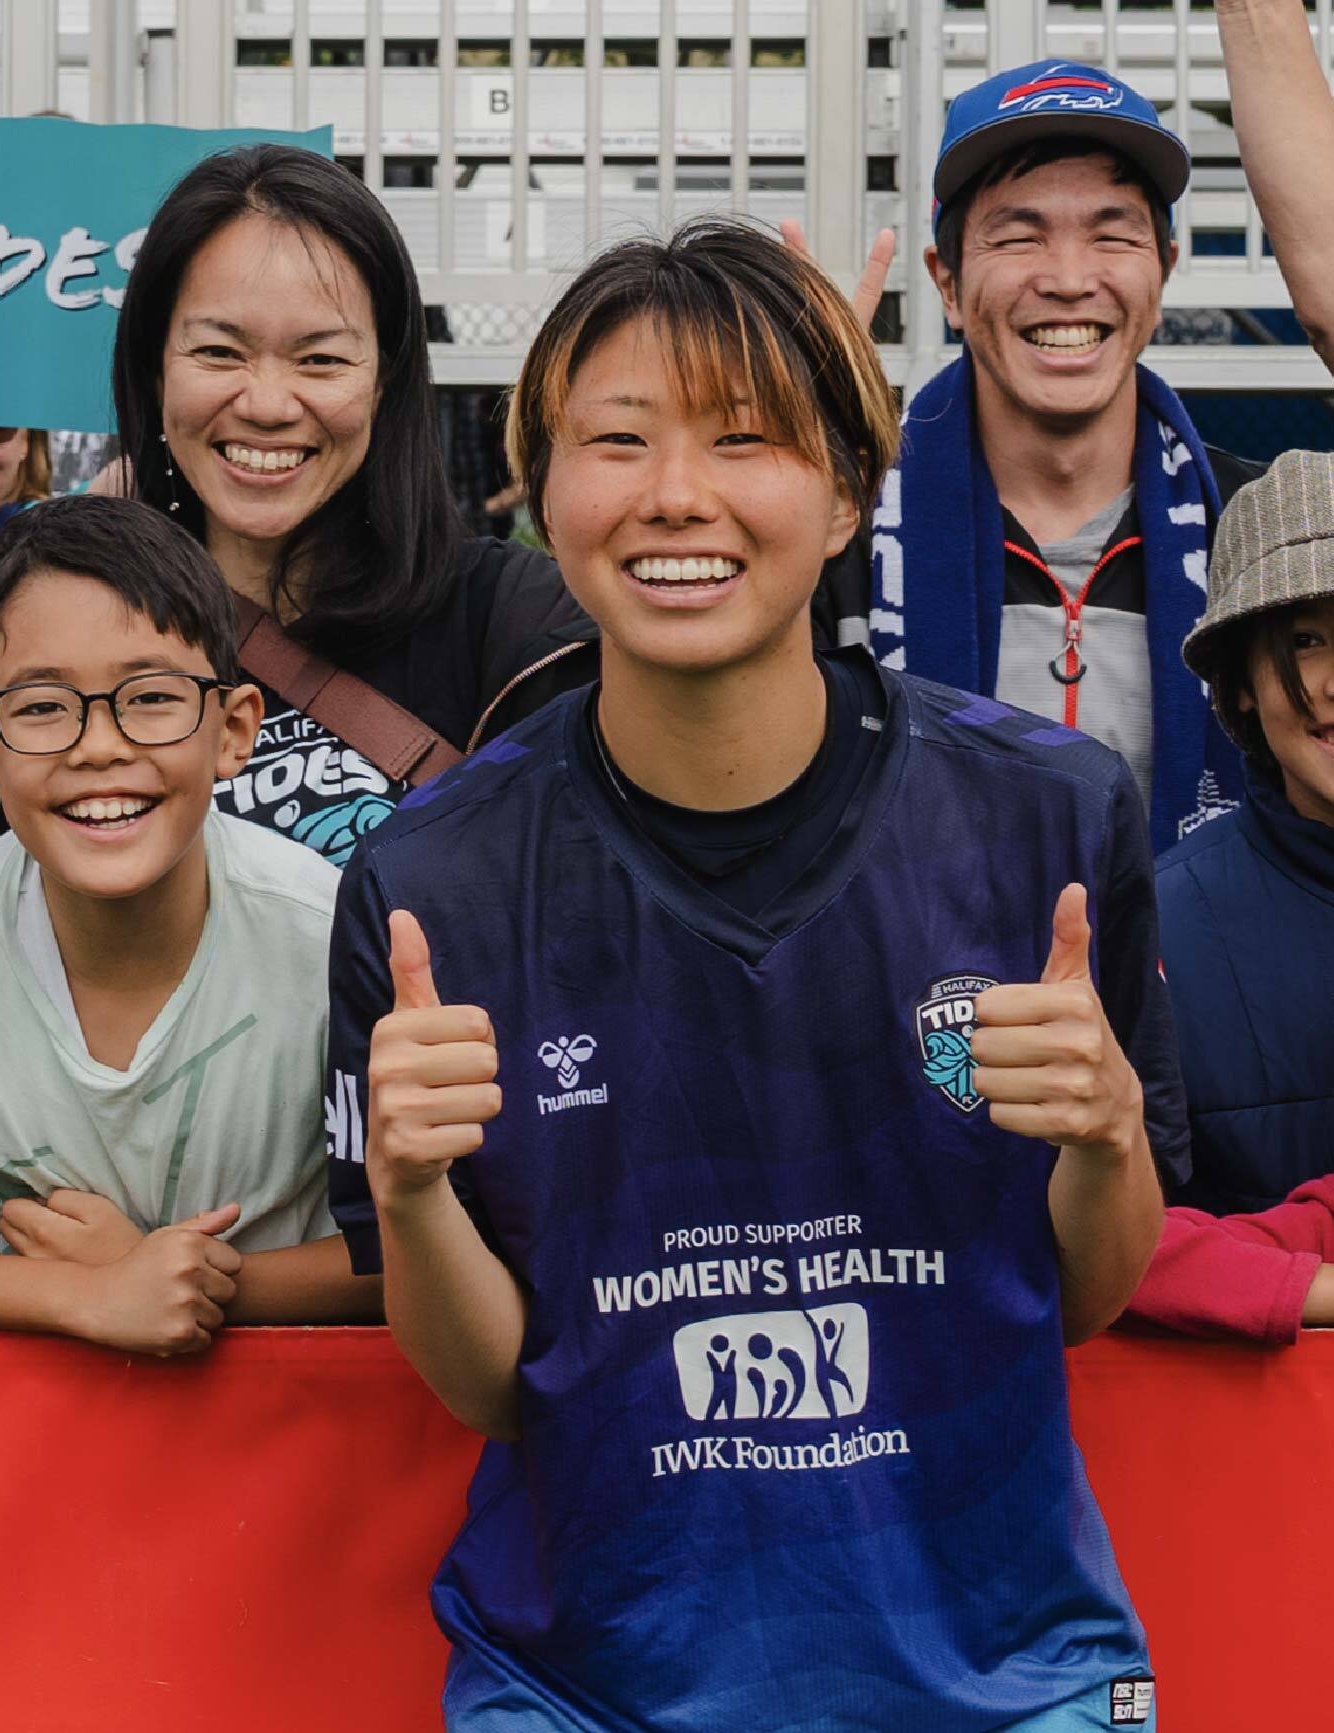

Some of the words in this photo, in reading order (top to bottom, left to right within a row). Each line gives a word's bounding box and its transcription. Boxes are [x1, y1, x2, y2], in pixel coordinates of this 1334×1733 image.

[489, 89, 510, 114] B
[921, 999, 978, 1030] TID
[536, 1082, 609, 1116] hummel
[663, 1225, 739, 1252] PROUD
[745, 1214, 863, 1244] SUPPORTER
[592, 1255, 787, 1313] WOMEN'S
[798, 1248, 946, 1293] HEALTH
[650, 1435, 732, 1477] IWK
[730, 1424, 911, 1471] Foundation
